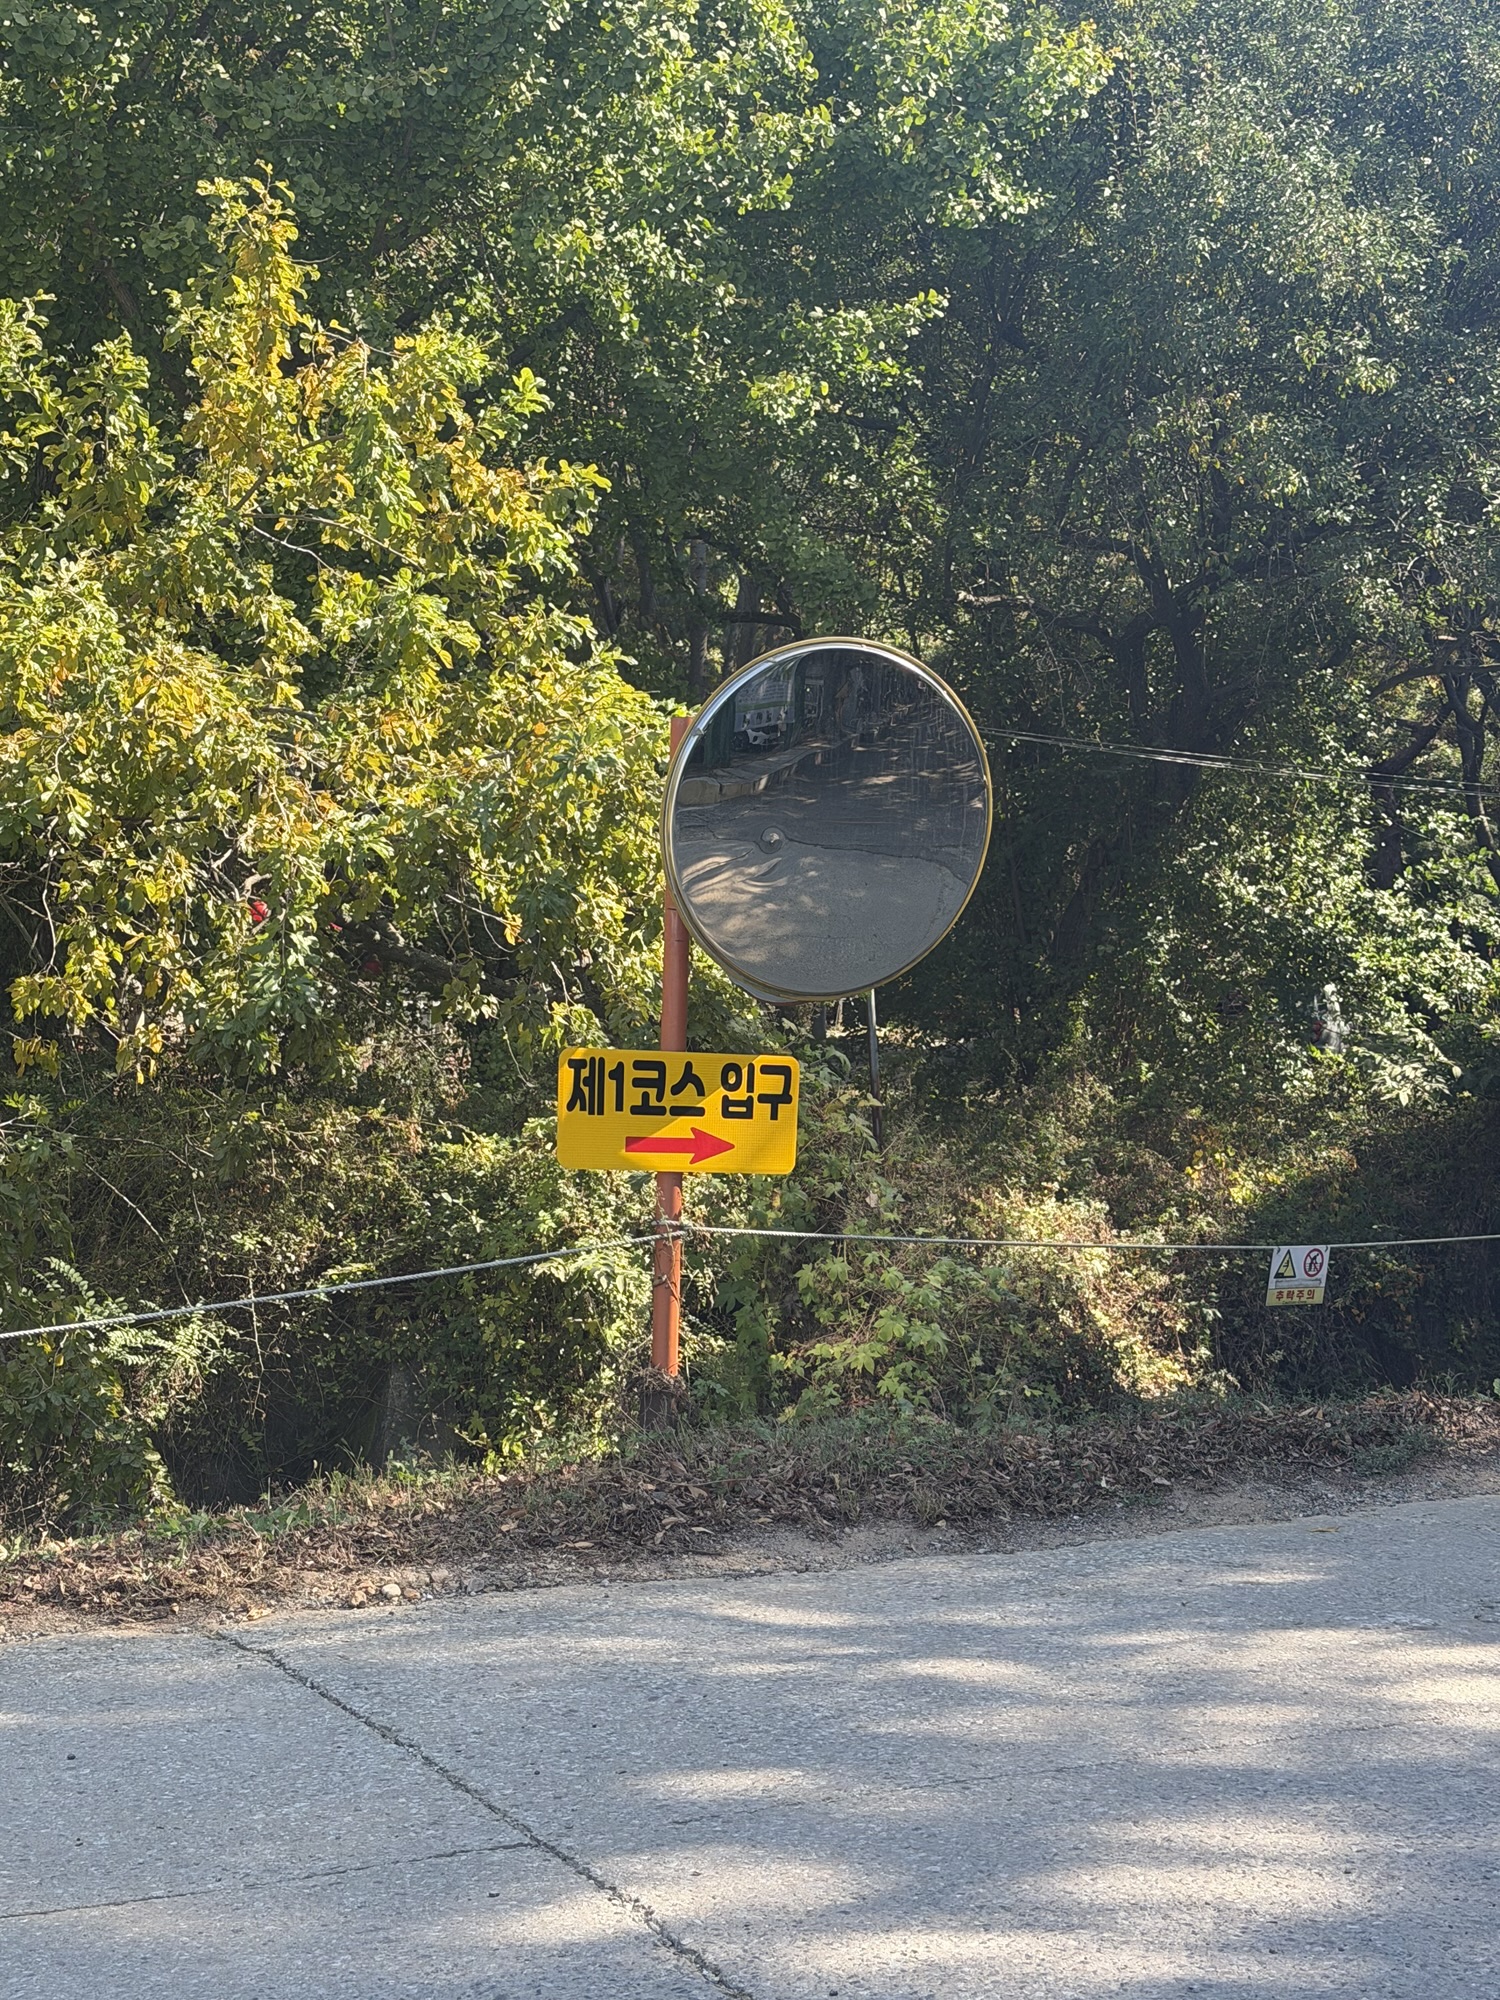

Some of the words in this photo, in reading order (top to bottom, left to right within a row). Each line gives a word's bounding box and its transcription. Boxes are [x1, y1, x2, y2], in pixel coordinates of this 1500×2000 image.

[566, 1056, 706, 1117] 제1코스
[720, 1062, 793, 1120] 입구
[1275, 1289, 1316, 1301] 추락주의
